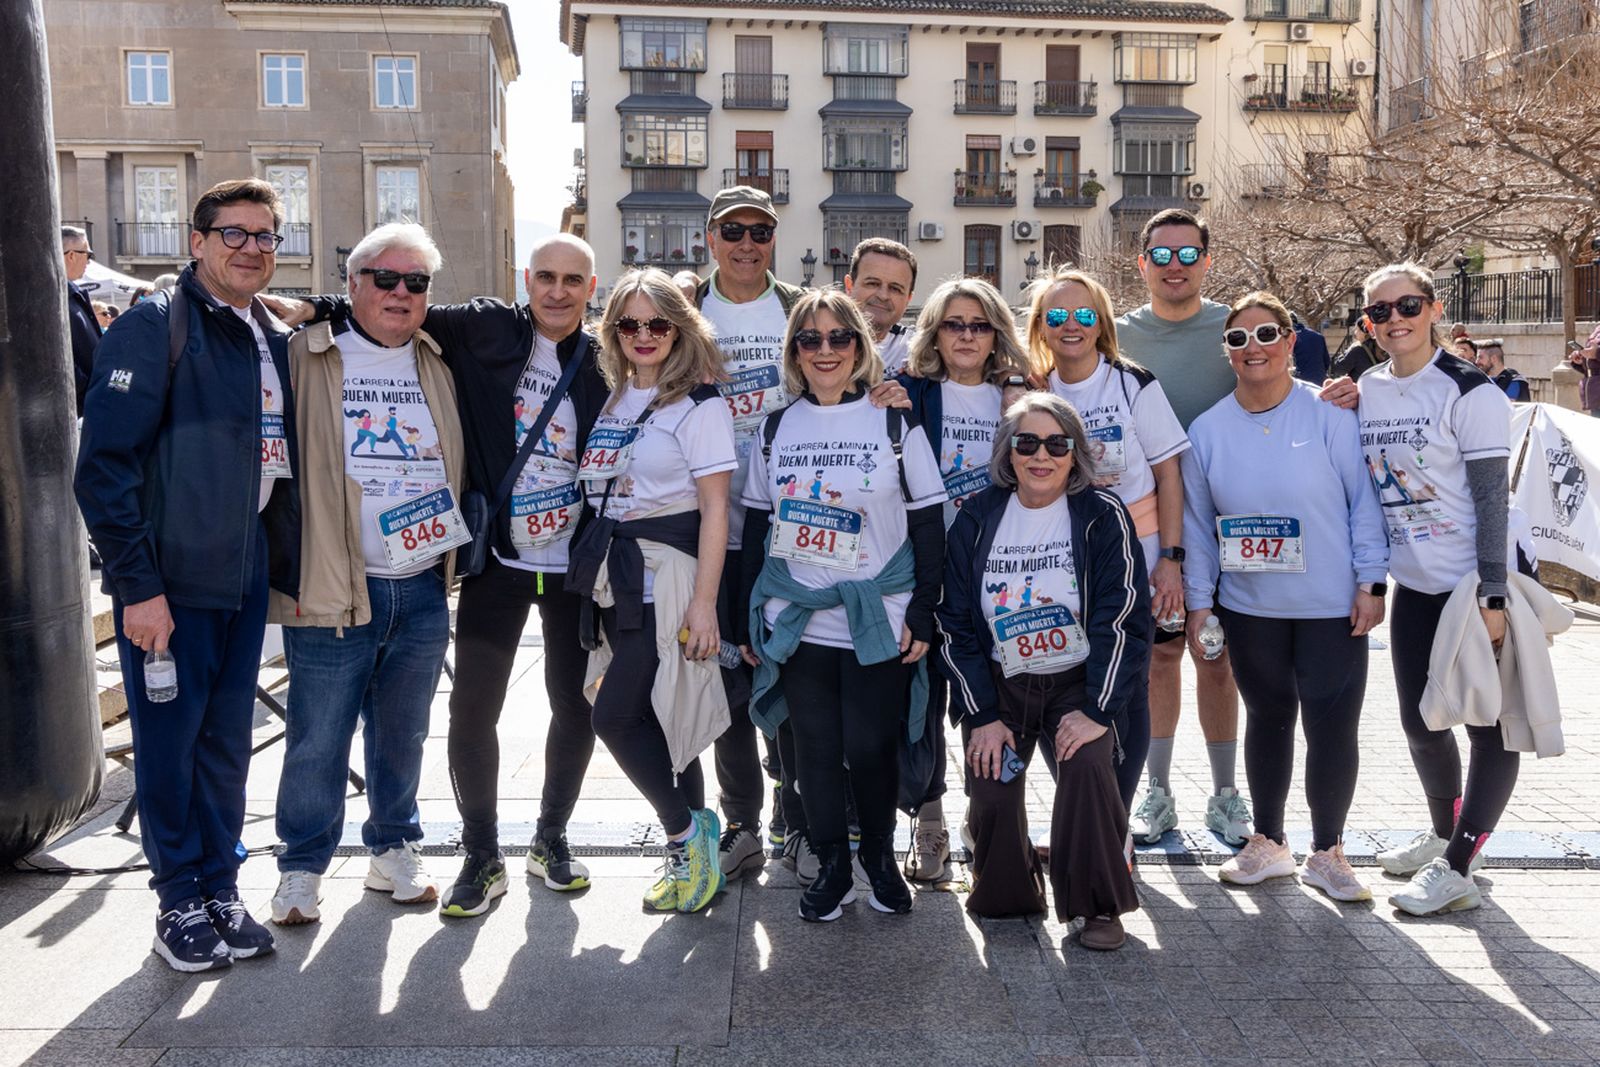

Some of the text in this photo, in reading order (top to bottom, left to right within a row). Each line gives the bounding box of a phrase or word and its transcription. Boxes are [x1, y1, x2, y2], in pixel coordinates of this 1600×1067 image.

[714, 334, 784, 345] ARRERA CAMINAT
[732, 348, 774, 362] MUERTE
[352, 378, 396, 387] CARRERA
[342, 390, 422, 404] BUENA MUERTE
[952, 429, 992, 442] MUERTE
[1376, 430, 1408, 445] MUERTE
[790, 441, 829, 452] CARRERA
[832, 441, 879, 451] CAMINATA
[580, 449, 620, 468] 844
[778, 454, 856, 468] BUENA MUERTE
[538, 497, 564, 510] MUERTE
[410, 506, 434, 522] MUERTE
[787, 510, 838, 528] BUENA MUERTE
[824, 507, 853, 519] CAMINATA
[527, 508, 569, 535] 845
[401, 517, 446, 550] 846
[1230, 526, 1279, 536] BUENA MUERTE
[796, 525, 837, 553] 841
[997, 545, 1036, 554] CARRERA
[1038, 542, 1070, 553] CAMINA
[1241, 538, 1284, 558] 847
[985, 555, 1060, 573] BUENA MUERTE
[1005, 617, 1056, 636] BUENA MUERTE
[1017, 628, 1066, 658] 840
